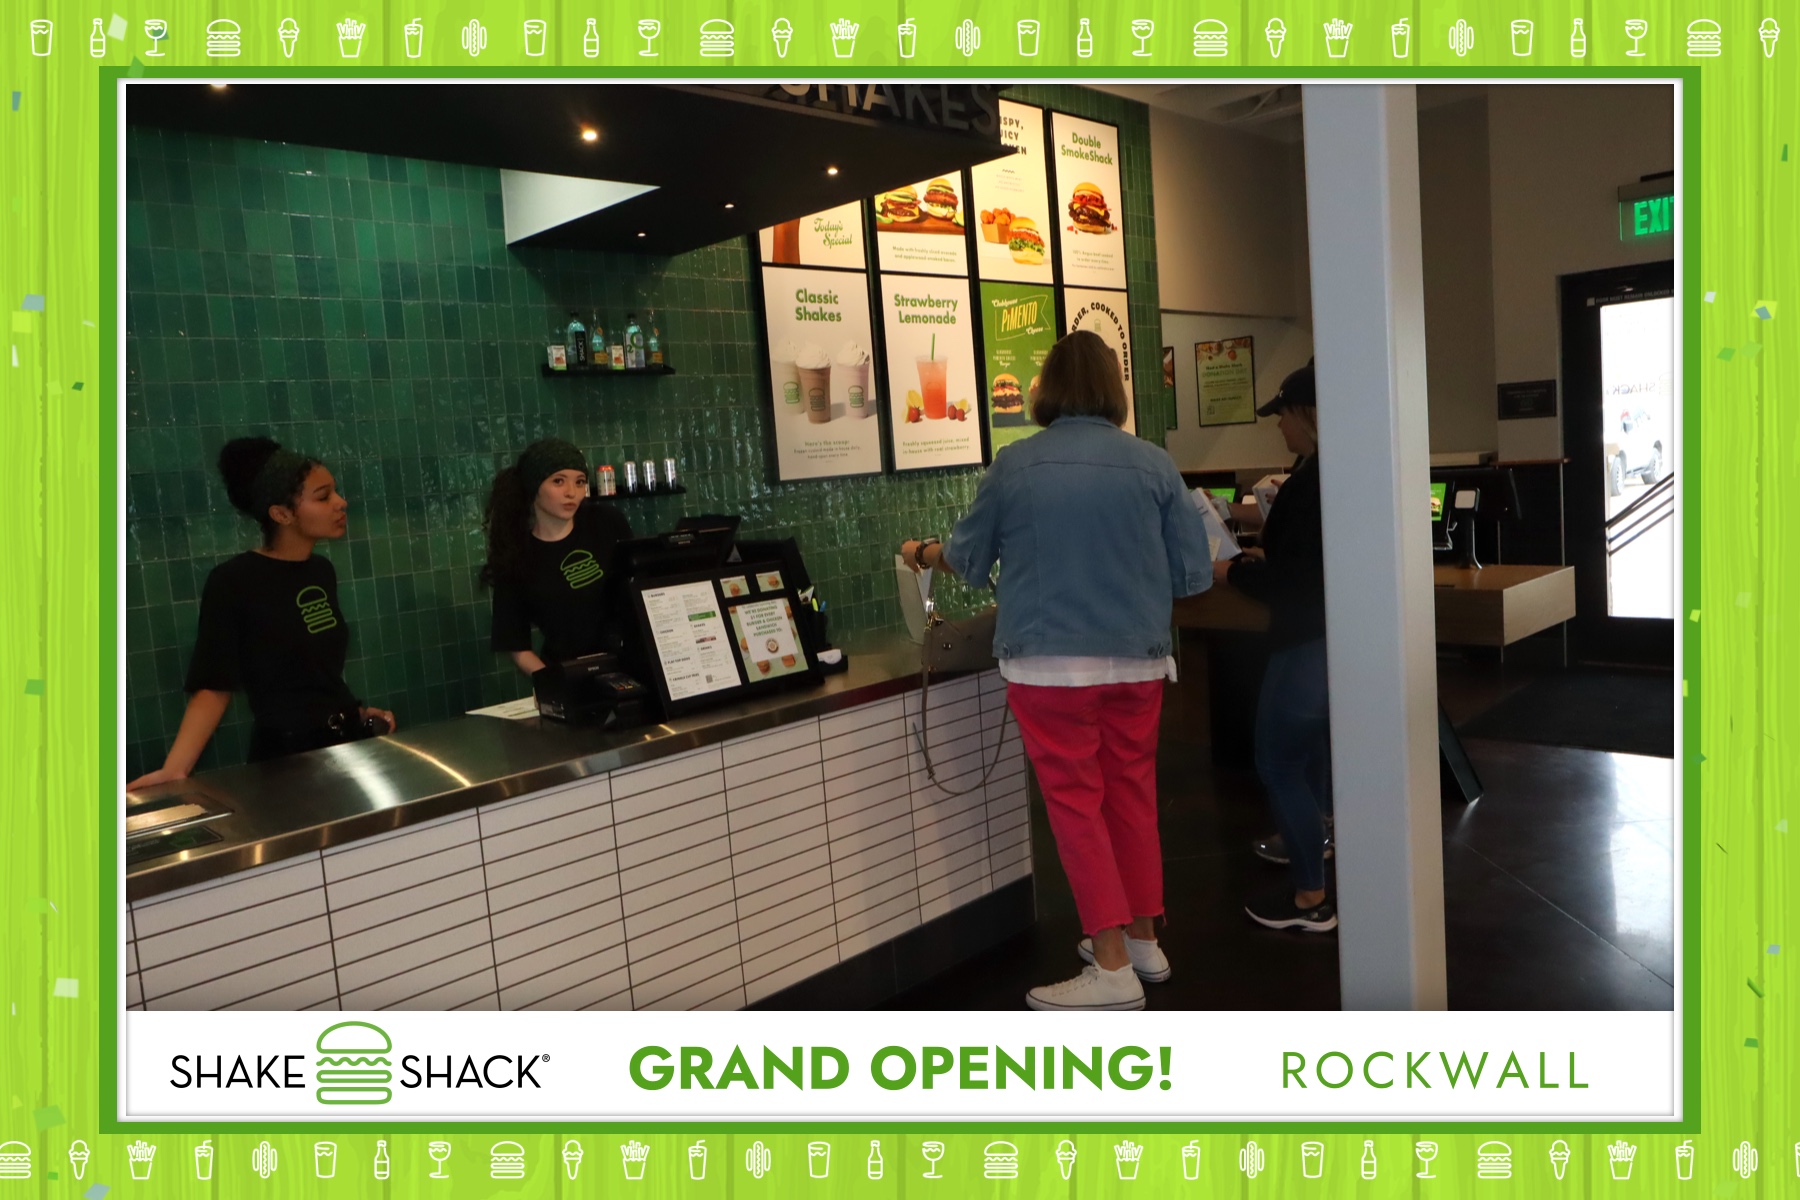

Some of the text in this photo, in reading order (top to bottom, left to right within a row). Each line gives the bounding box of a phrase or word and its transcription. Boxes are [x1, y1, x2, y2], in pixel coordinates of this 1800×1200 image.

[1072, 131, 1102, 149] Double
[1061, 144, 1114, 166] SmokeShack
[814, 217, 843, 238] Today's
[823, 232, 853, 249] Special
[796, 288, 839, 304] Classic
[894, 293, 958, 312] Strawberry
[795, 306, 842, 322] Shakes
[898, 310, 957, 324] Lemonade
[1071, 302, 1130, 382] RDER, COOKED TO ORDER
